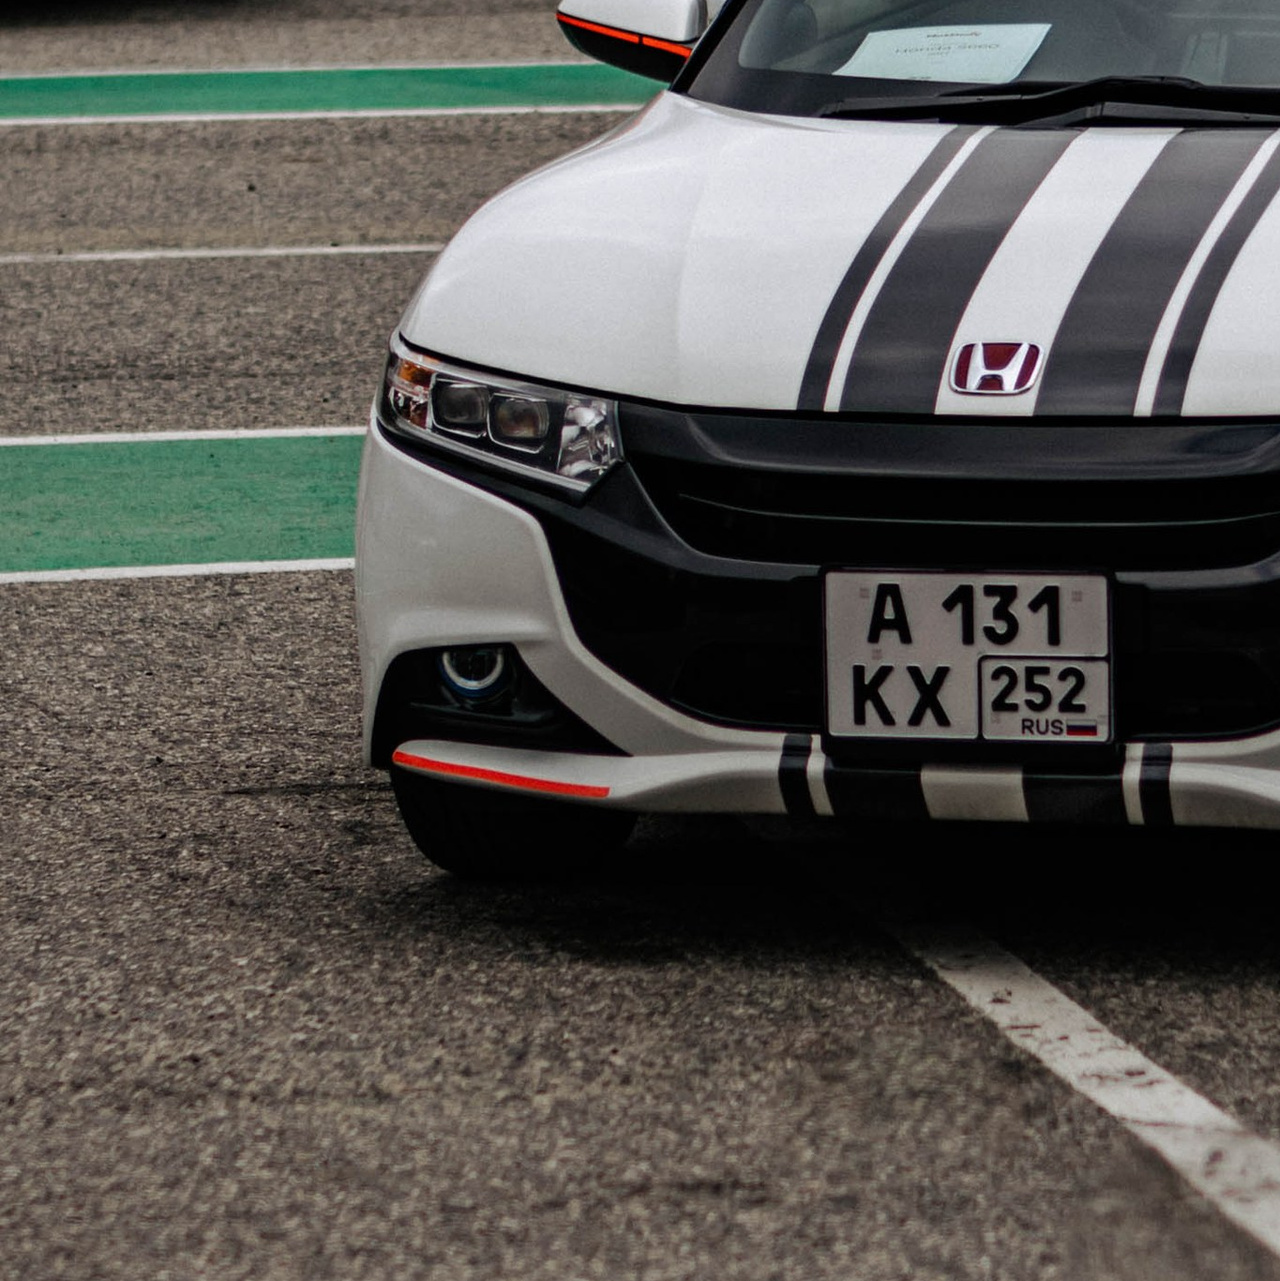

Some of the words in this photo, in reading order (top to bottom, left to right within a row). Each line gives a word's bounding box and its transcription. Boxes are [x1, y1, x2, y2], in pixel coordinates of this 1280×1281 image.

[867, 583, 913, 645] A
[941, 584, 1061, 647] 131
[852, 664, 951, 727] KX
[990, 666, 1086, 713] 252
[1021, 719, 1065, 736] RUS
